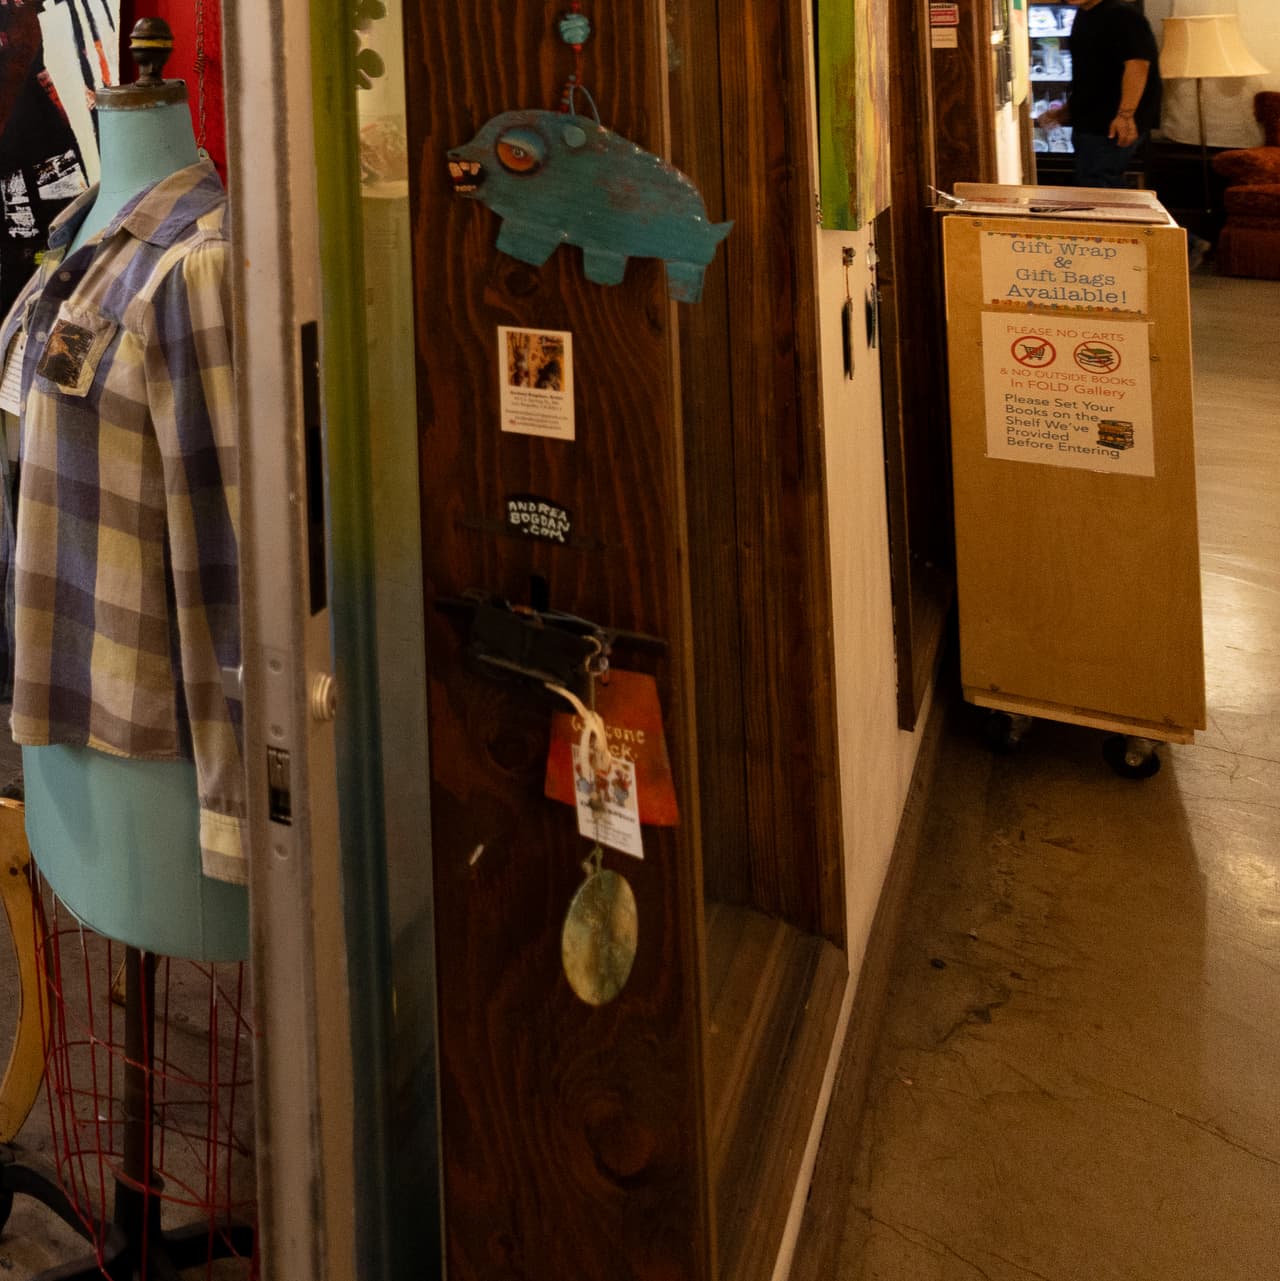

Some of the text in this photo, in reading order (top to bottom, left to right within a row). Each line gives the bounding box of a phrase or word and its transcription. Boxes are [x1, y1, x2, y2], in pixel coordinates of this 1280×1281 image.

[1011, 240, 1117, 259] Gift Wrap
[1054, 256, 1072, 269] &
[1016, 268, 1116, 288] Gift Bags
[1007, 284, 1128, 304] Available!
[1006, 326, 1127, 342] PLEASE NO CARTS
[1011, 368, 1033, 378] NO
[1035, 370, 1088, 383] OUTSIDE
[1091, 374, 1137, 387] BOOKS
[1010, 379, 1127, 400] In FOLD Gallery
[1005, 393, 1115, 413] Please Set Your
[1005, 404, 1100, 422] Books on the
[1006, 415, 1089, 433] Shelf We've
[1006, 427, 1069, 441] Provided
[1007, 437, 1121, 459] Before Entering
[508, 501, 567, 522] ANDREA
[510, 512, 571, 532] BOGDAN
[522, 524, 565, 543] .COM
